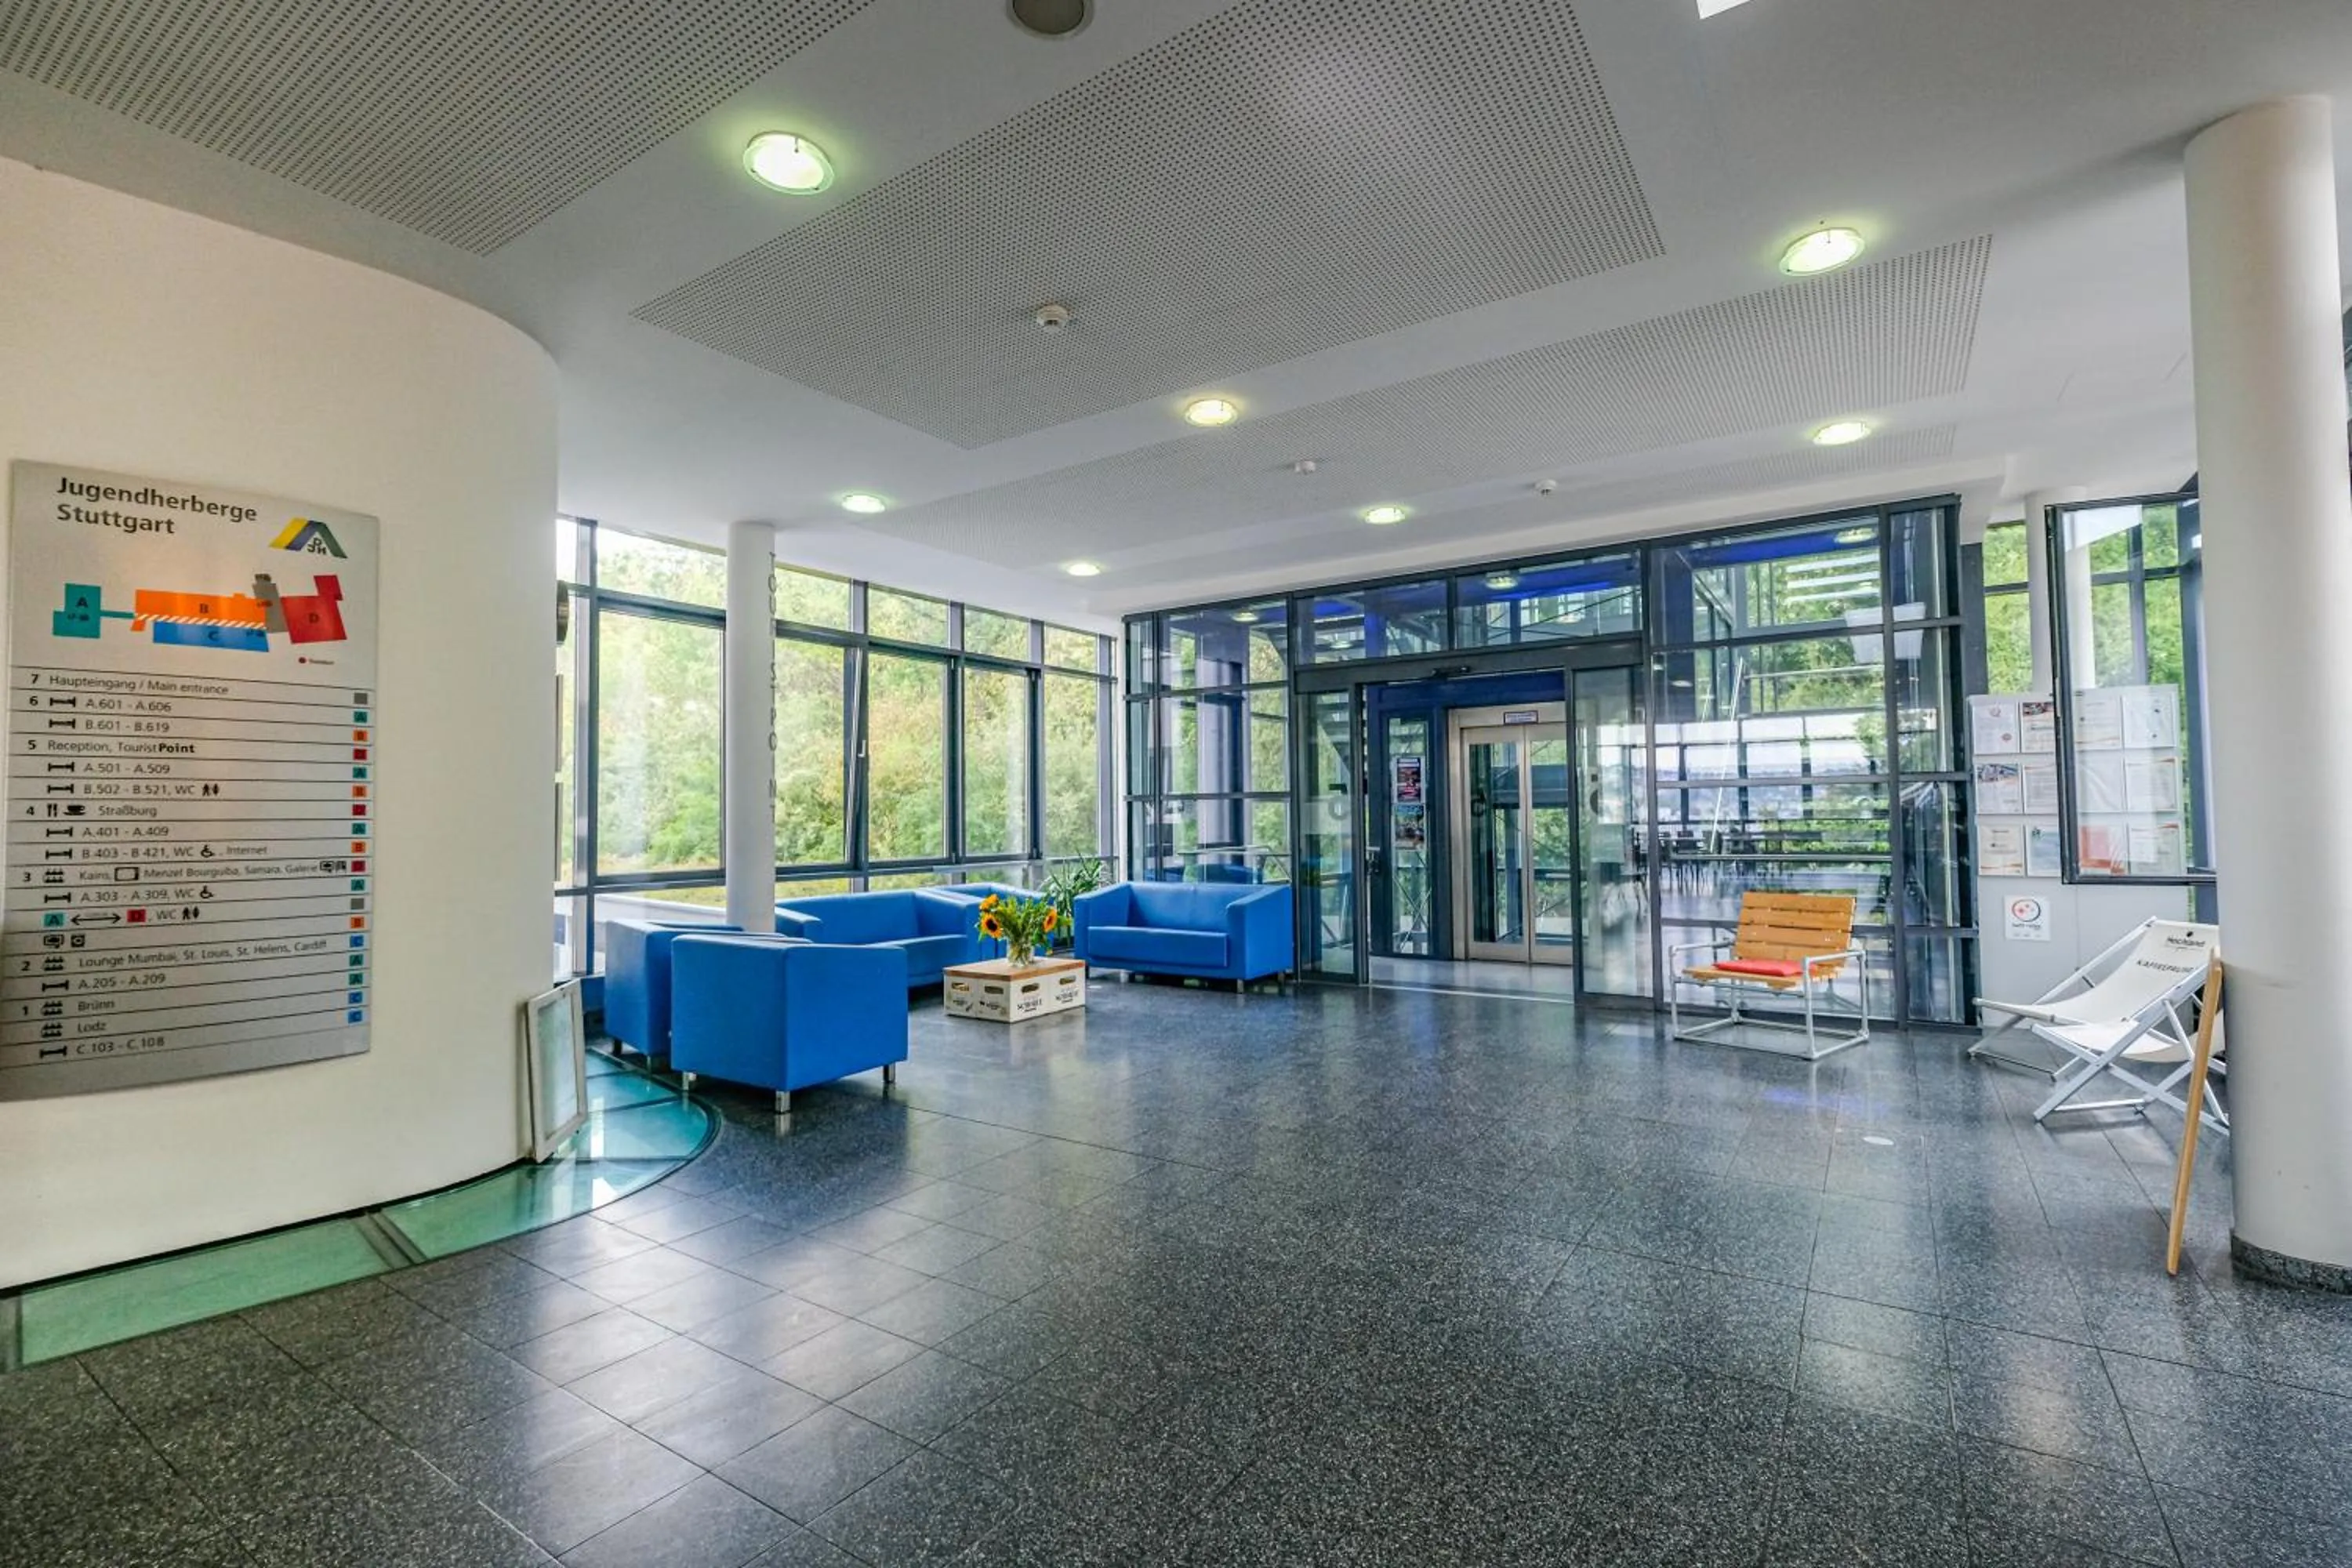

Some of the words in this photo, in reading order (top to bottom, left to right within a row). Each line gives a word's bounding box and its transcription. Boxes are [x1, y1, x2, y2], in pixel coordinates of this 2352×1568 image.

[56, 477, 258, 522] Jugendherberge
[57, 504, 176, 535] Stuttgart
[75, 597, 89, 608] A
[200, 603, 209, 614] B
[208, 630, 220, 641] C
[31, 673, 39, 684] 7
[49, 676, 136, 691] Haupteingang
[147, 680, 176, 691] Main
[180, 683, 229, 695] entrance
[29, 695, 38, 706] 6
[86, 699, 122, 710] A.601
[135, 702, 172, 712] A.606
[85, 719, 121, 730] B.601
[134, 722, 170, 733] B.619
[27, 739, 36, 750] 5
[48, 740, 112, 755] Reception,
[83, 762, 120, 773] A.501
[133, 764, 170, 774] A.509
[175, 785, 195, 795] WC
[26, 805, 35, 816] 4
[98, 804, 158, 818] Straßburg
[82, 826, 119, 838] A.401
[132, 826, 169, 837] A.409
[174, 847, 194, 857] WC
[227, 846, 267, 855] Internet
[22, 871, 31, 882] 3
[81, 891, 118, 902] A.303
[174, 888, 194, 898] WC
[48, 915, 61, 925] A
[157, 910, 176, 920] WC
[21, 961, 31, 971] 2
[79, 956, 124, 967] Lounge
[294, 940, 327, 952] Cardiff
[129, 974, 166, 985] A.209
[22, 1006, 29, 1016] 1
